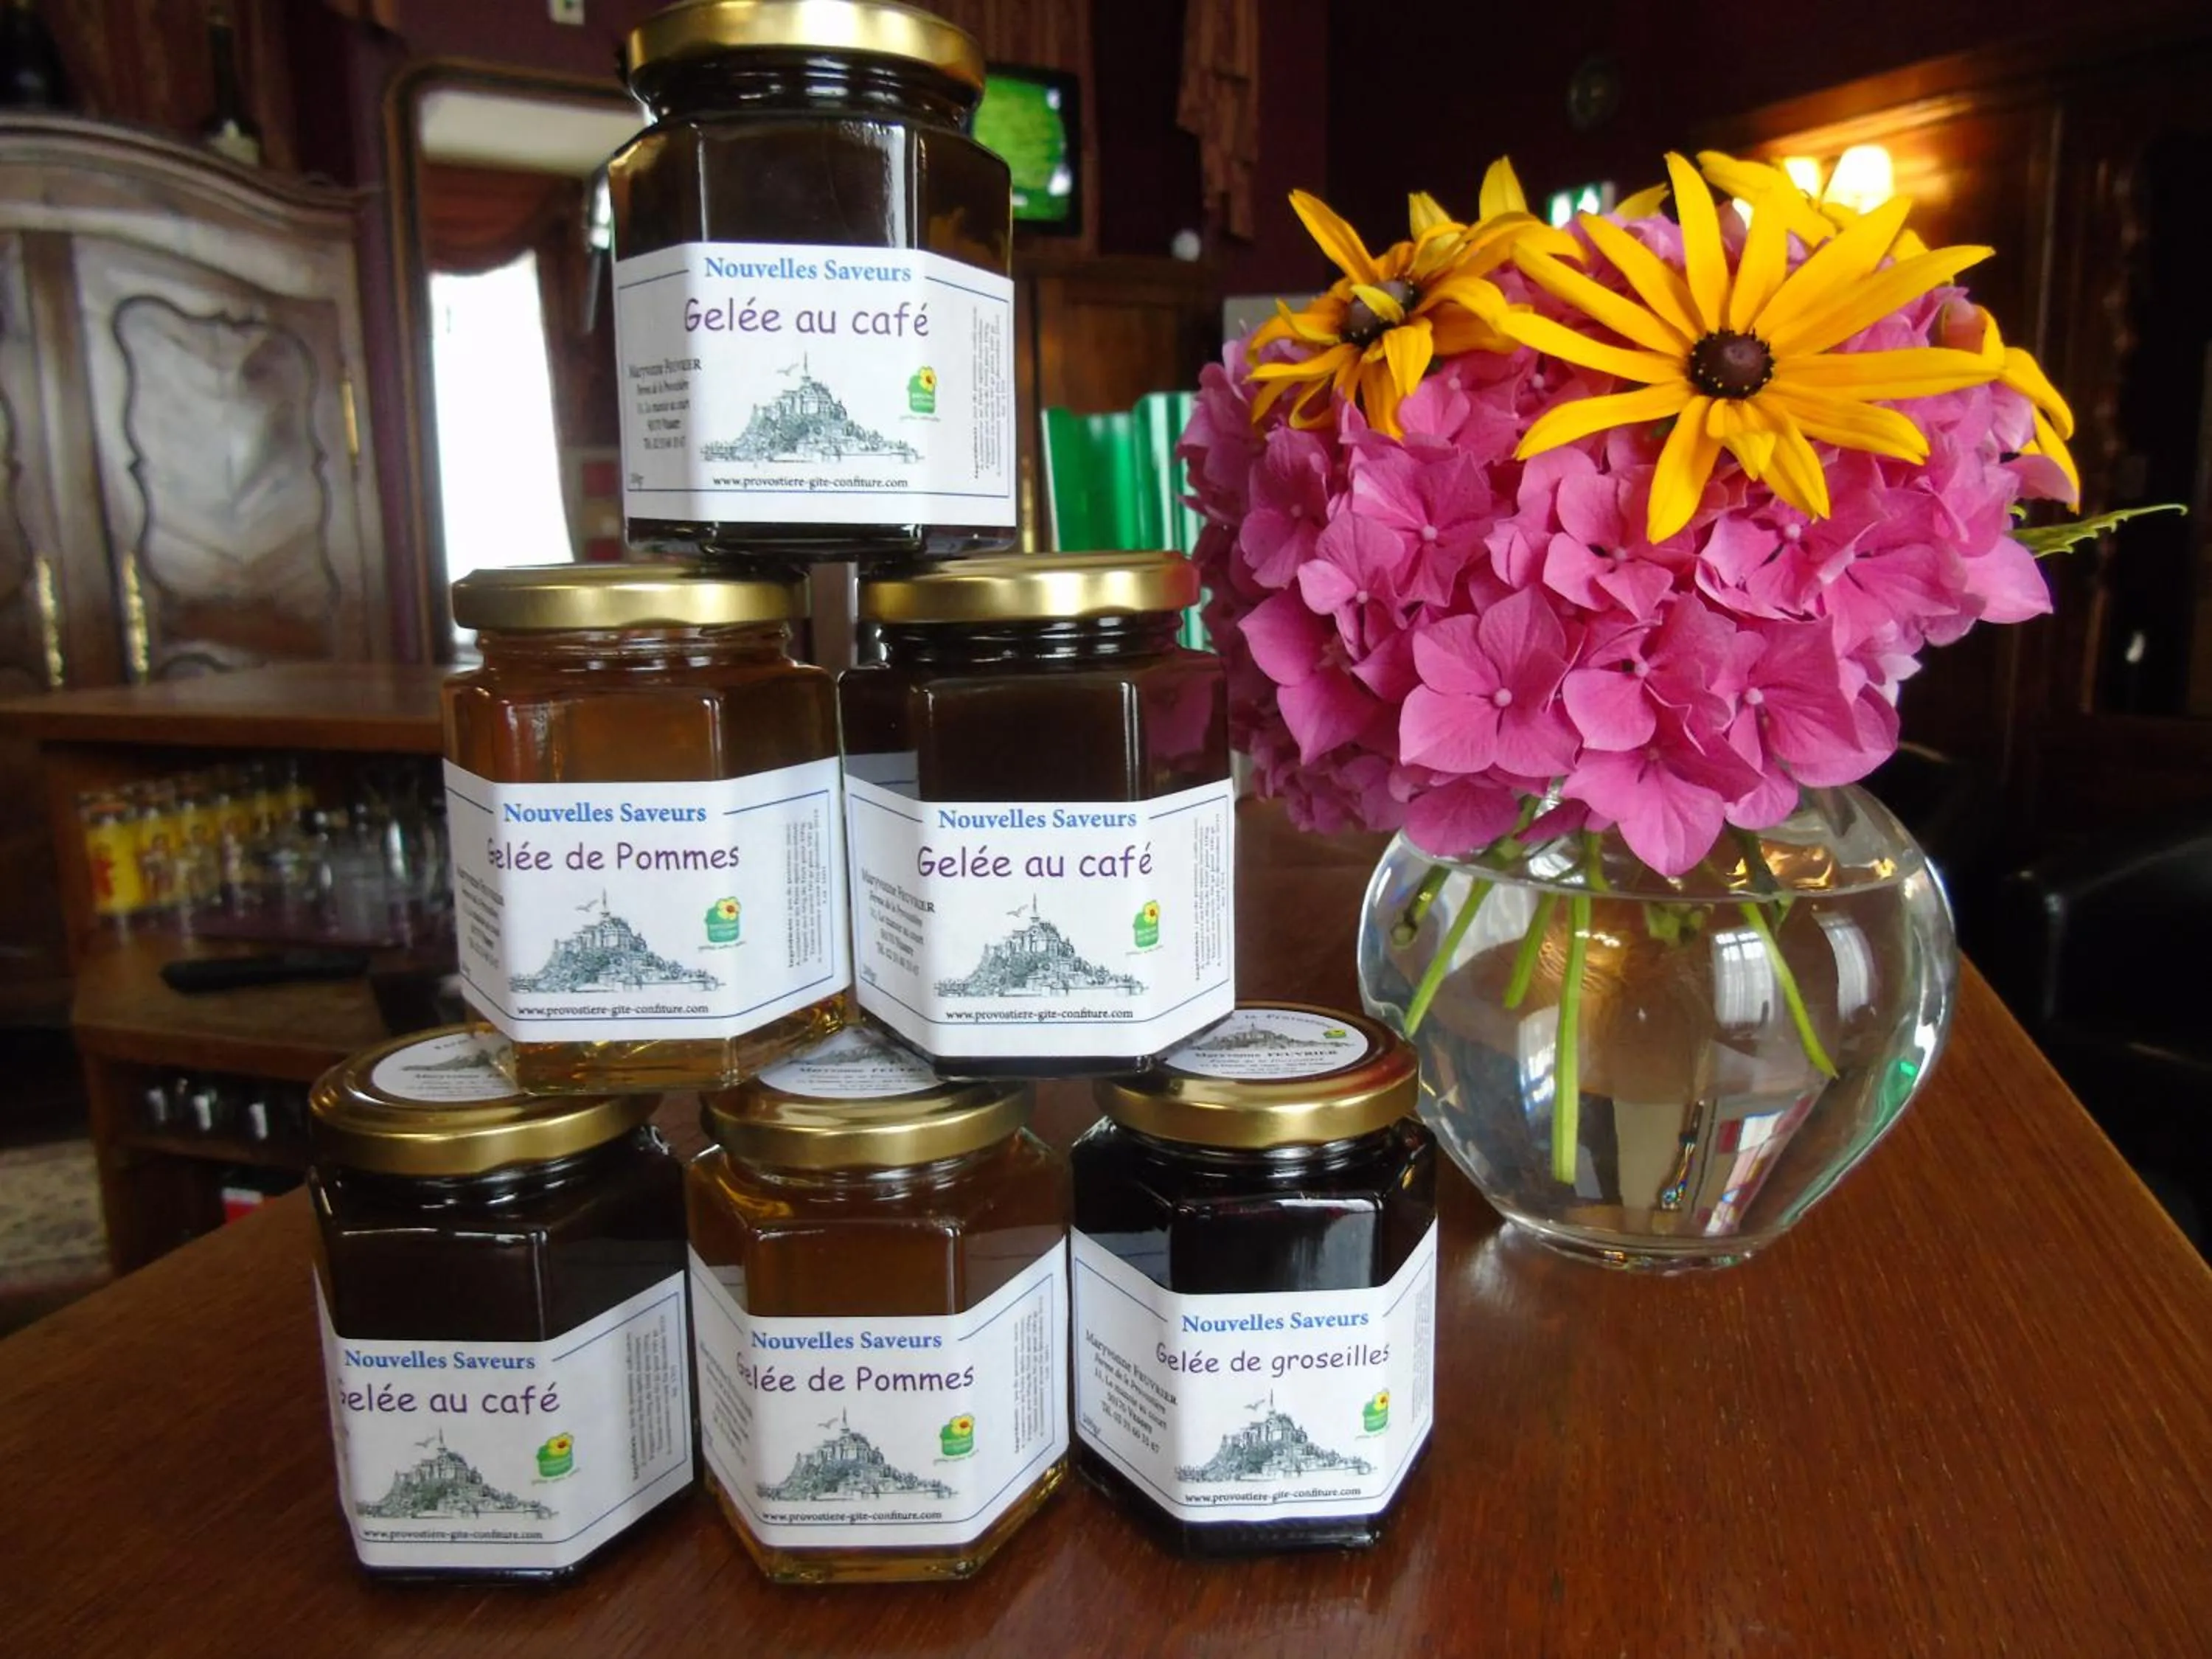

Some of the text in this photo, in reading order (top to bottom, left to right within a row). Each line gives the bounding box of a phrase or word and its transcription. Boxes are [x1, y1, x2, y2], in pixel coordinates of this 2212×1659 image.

[705, 257, 912, 282] Nouvelles Saveurs
[684, 296, 930, 338] Gelée au café
[504, 802, 707, 823] Nouvelles Saveurs
[938, 809, 1137, 829] Nouvelles Saveurs
[566, 842, 605, 871] de
[616, 841, 740, 872] Pommes
[917, 842, 1153, 878] Gelée au café
[1182, 1312, 1369, 1333] Nouvelles Saveurs
[751, 1331, 942, 1350] Nouvelles Saveurs
[344, 1349, 536, 1370] Nouvelles Saveurs
[1156, 1342, 1390, 1378] Gelée de groseilles
[808, 1366, 846, 1392] de
[857, 1365, 975, 1392] Pommes
[430, 1391, 468, 1413] au
[481, 1381, 561, 1415] café
